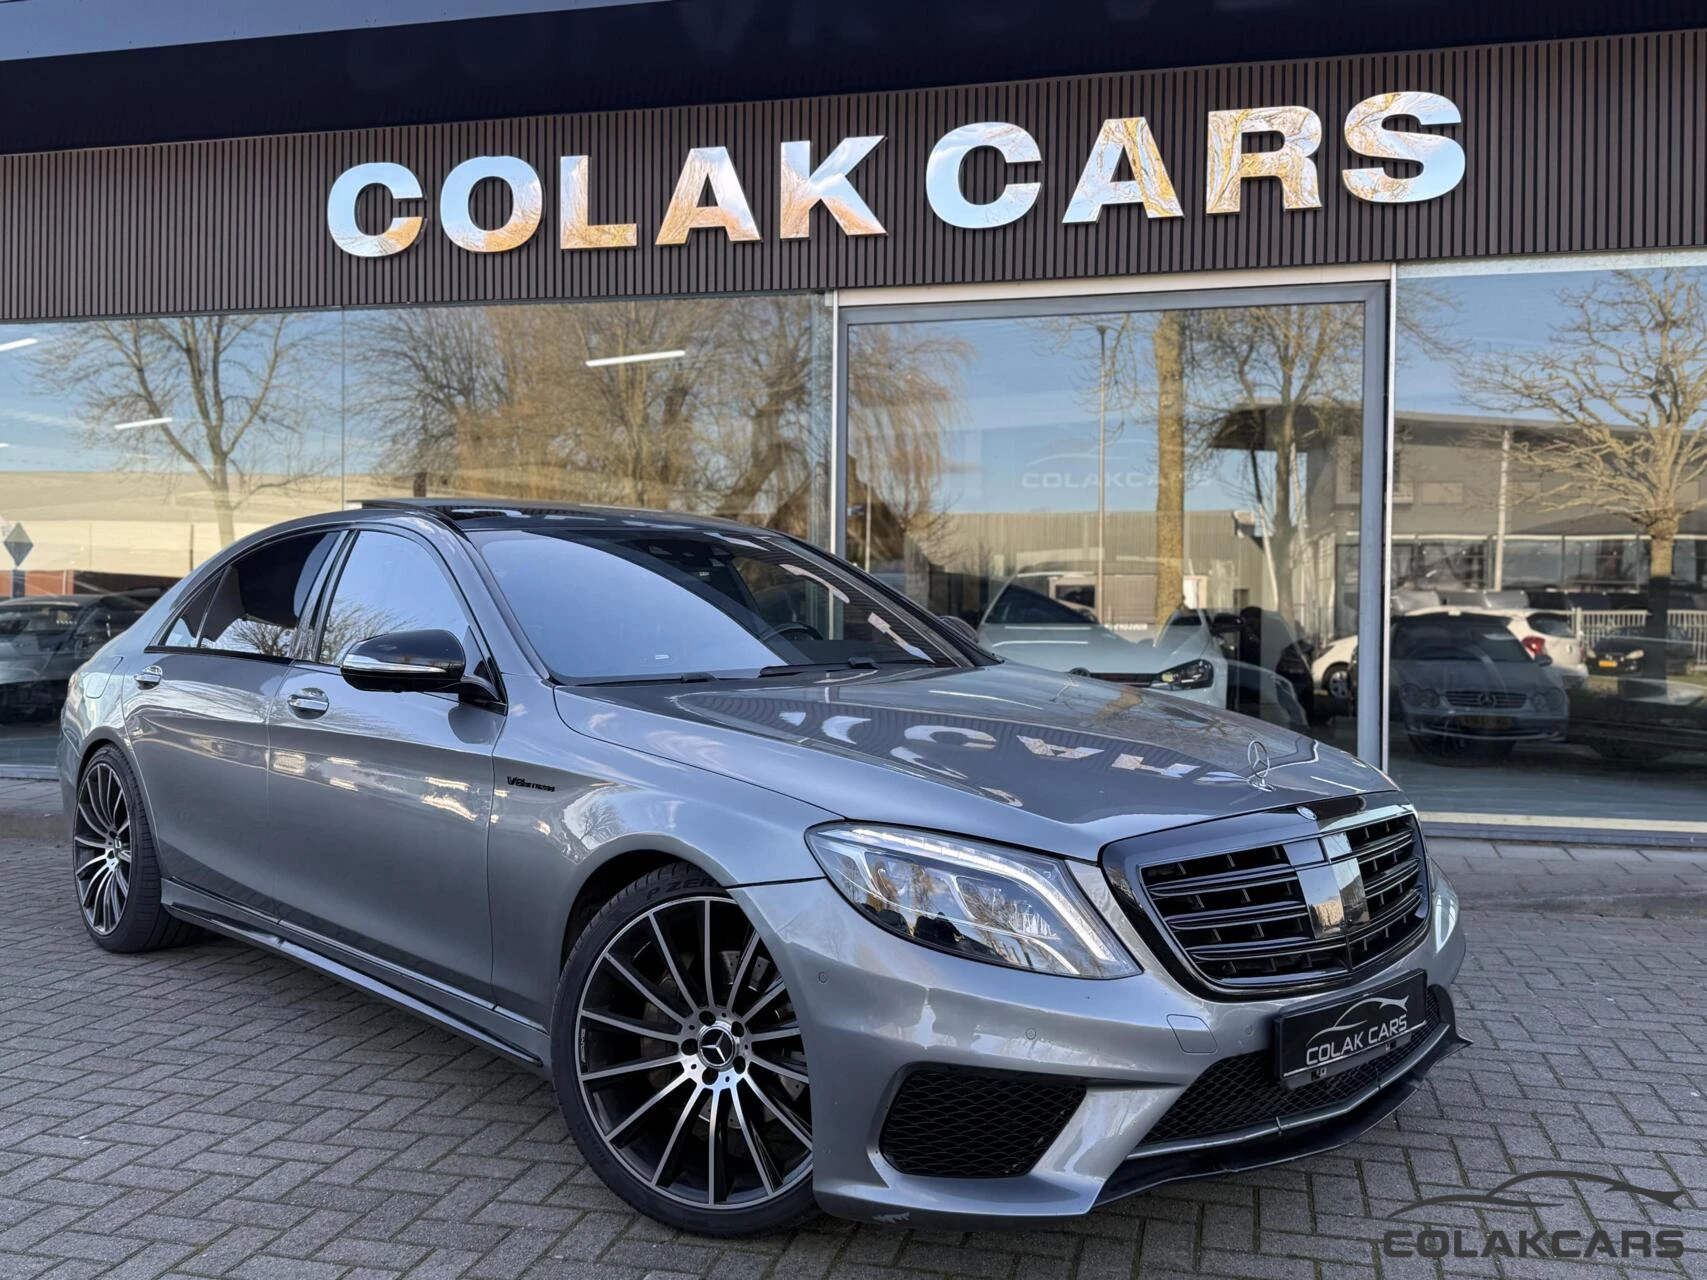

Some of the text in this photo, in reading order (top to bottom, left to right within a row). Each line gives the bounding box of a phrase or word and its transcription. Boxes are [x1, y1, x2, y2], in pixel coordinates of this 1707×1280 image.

[327, 91, 1466, 257] COLAK CARS
[665, 878, 719, 892] ZER
[1306, 1014, 1407, 1065] COLAK CARS
